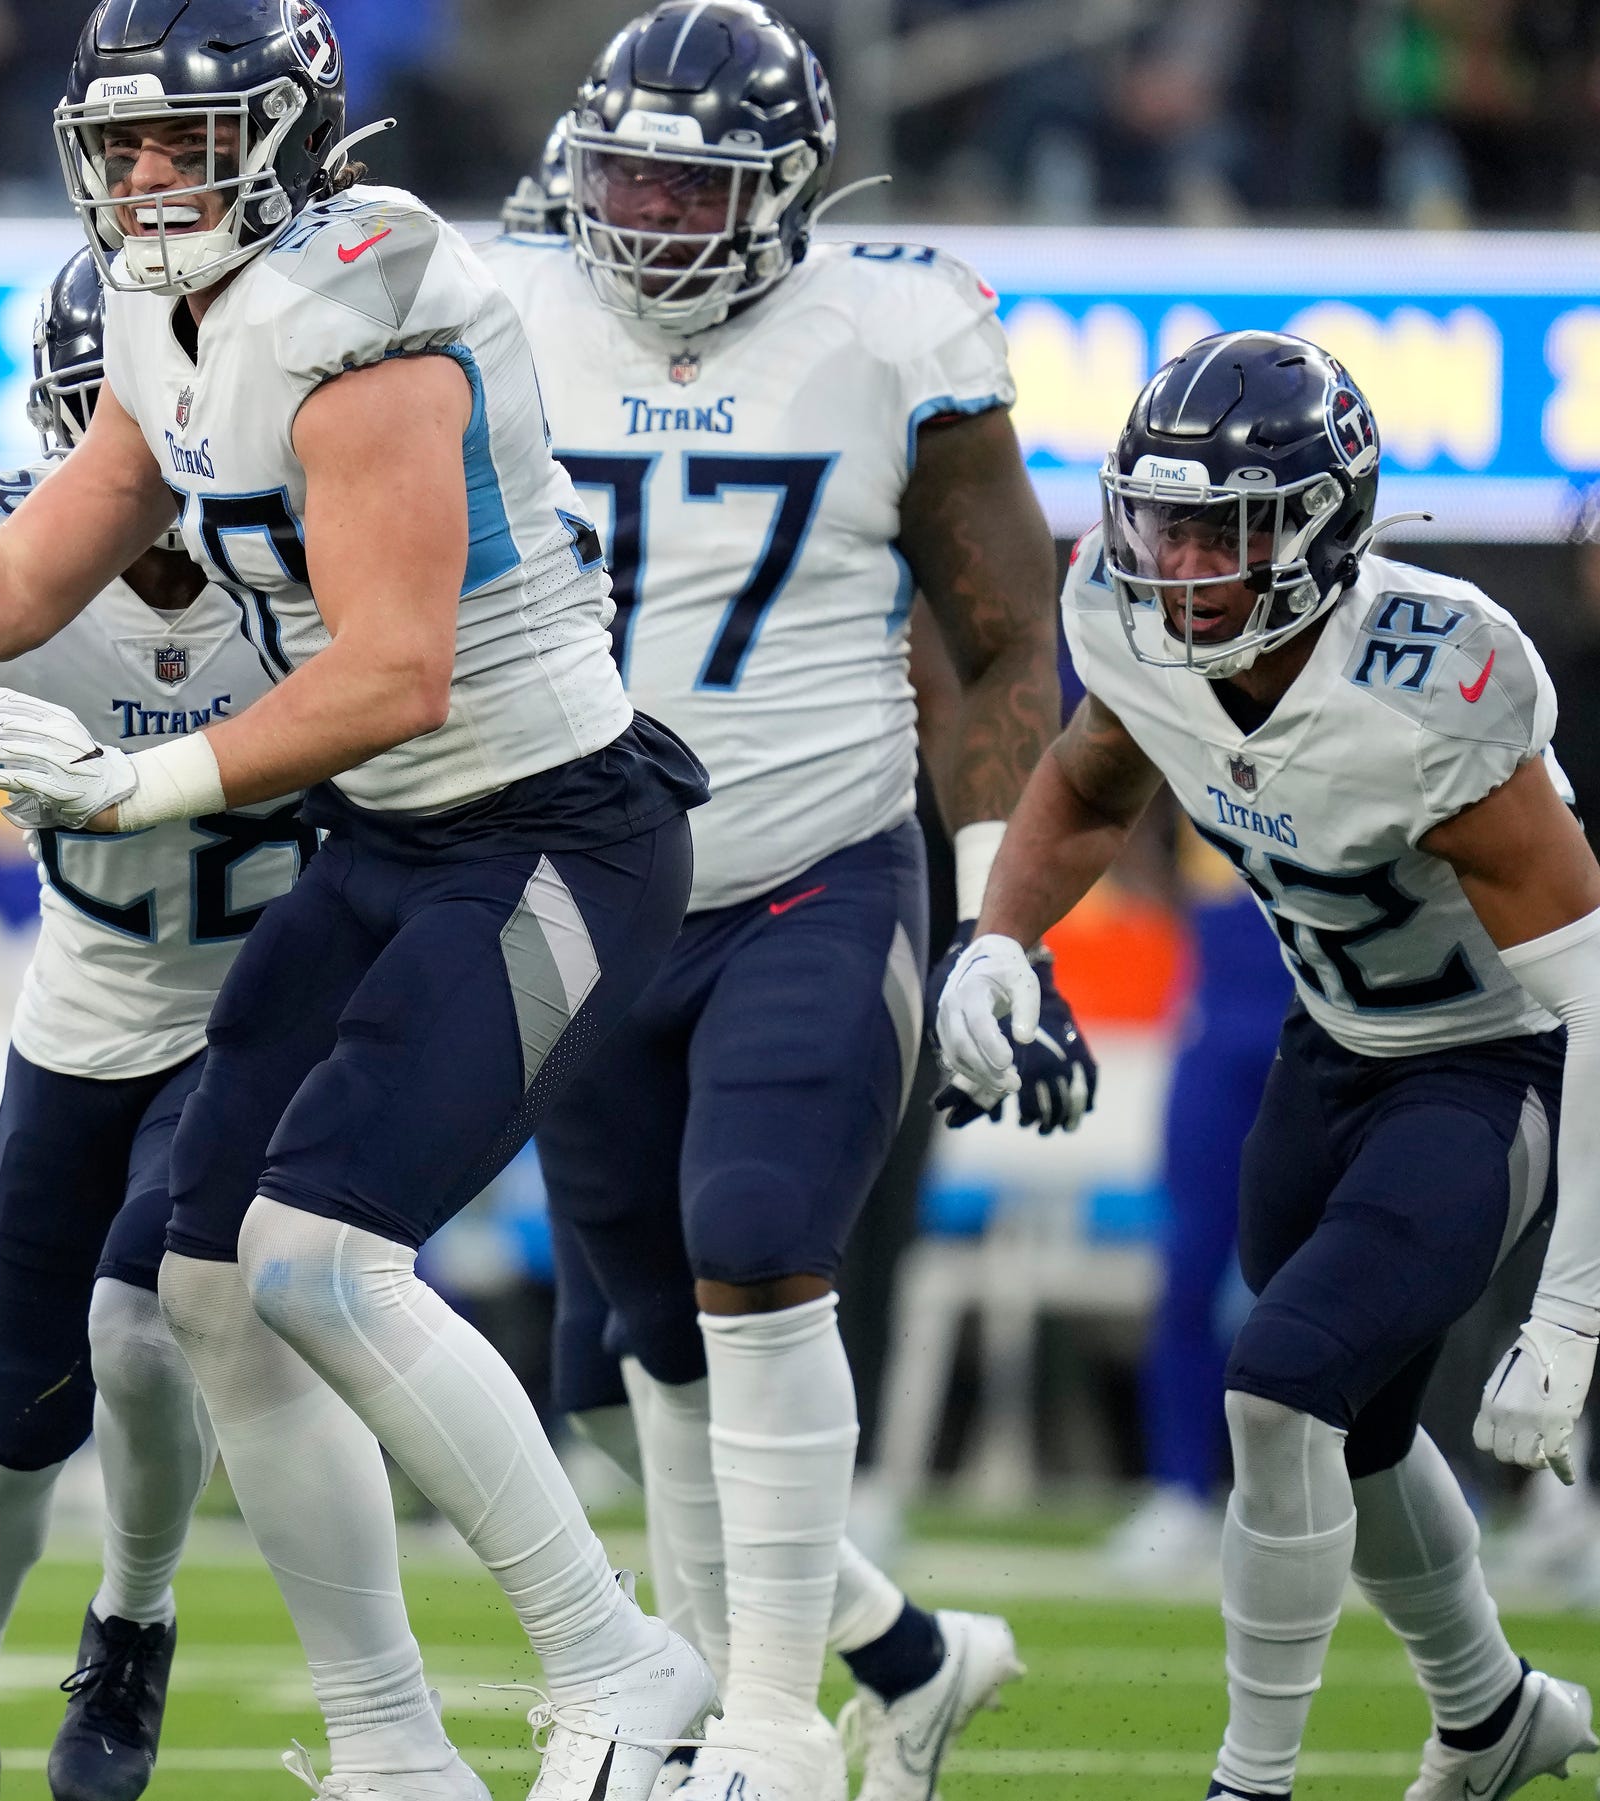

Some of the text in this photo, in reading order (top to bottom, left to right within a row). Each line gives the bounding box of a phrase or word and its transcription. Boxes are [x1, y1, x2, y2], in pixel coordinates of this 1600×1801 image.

[100, 80, 138, 98] TITANS
[621, 395, 736, 436] TITANS
[164, 429, 215, 480] TITANS
[1149, 462, 1187, 482] TITANS
[1350, 594, 1471, 693] 32
[160, 662, 185, 679] NFL
[1206, 784, 1299, 849] TITANS
[649, 1667, 675, 1680] VAPOR
